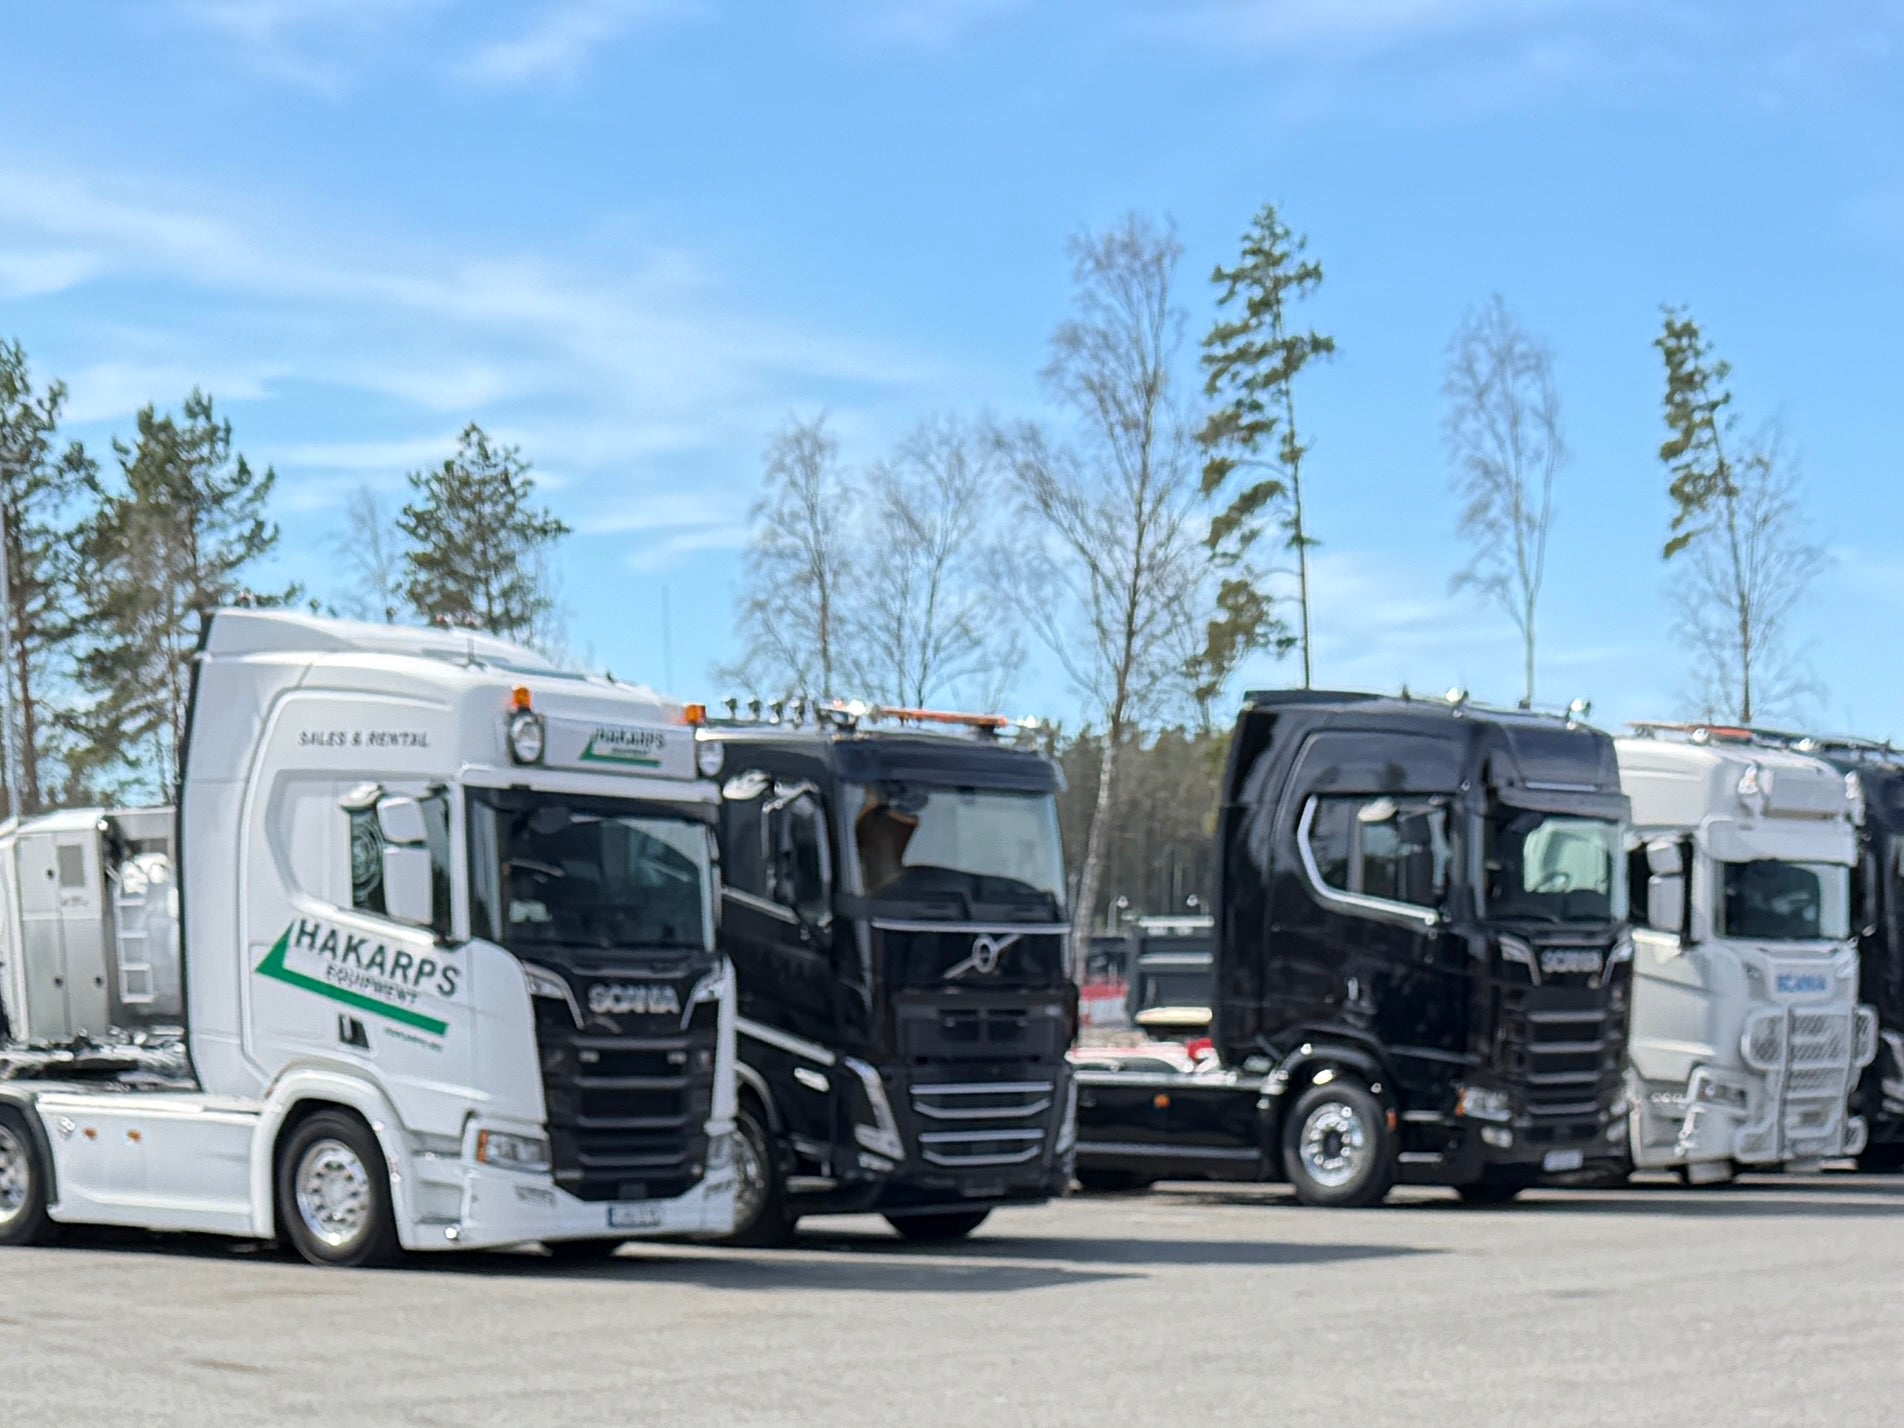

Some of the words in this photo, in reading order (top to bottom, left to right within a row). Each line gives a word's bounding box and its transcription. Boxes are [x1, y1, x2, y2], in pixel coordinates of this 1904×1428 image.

[299, 730, 346, 747] SALES
[351, 730, 362, 747] &
[366, 730, 429, 748] RENTAL
[295, 918, 462, 998] HAKARPS
[325, 963, 418, 1005] EQUIPMENT
